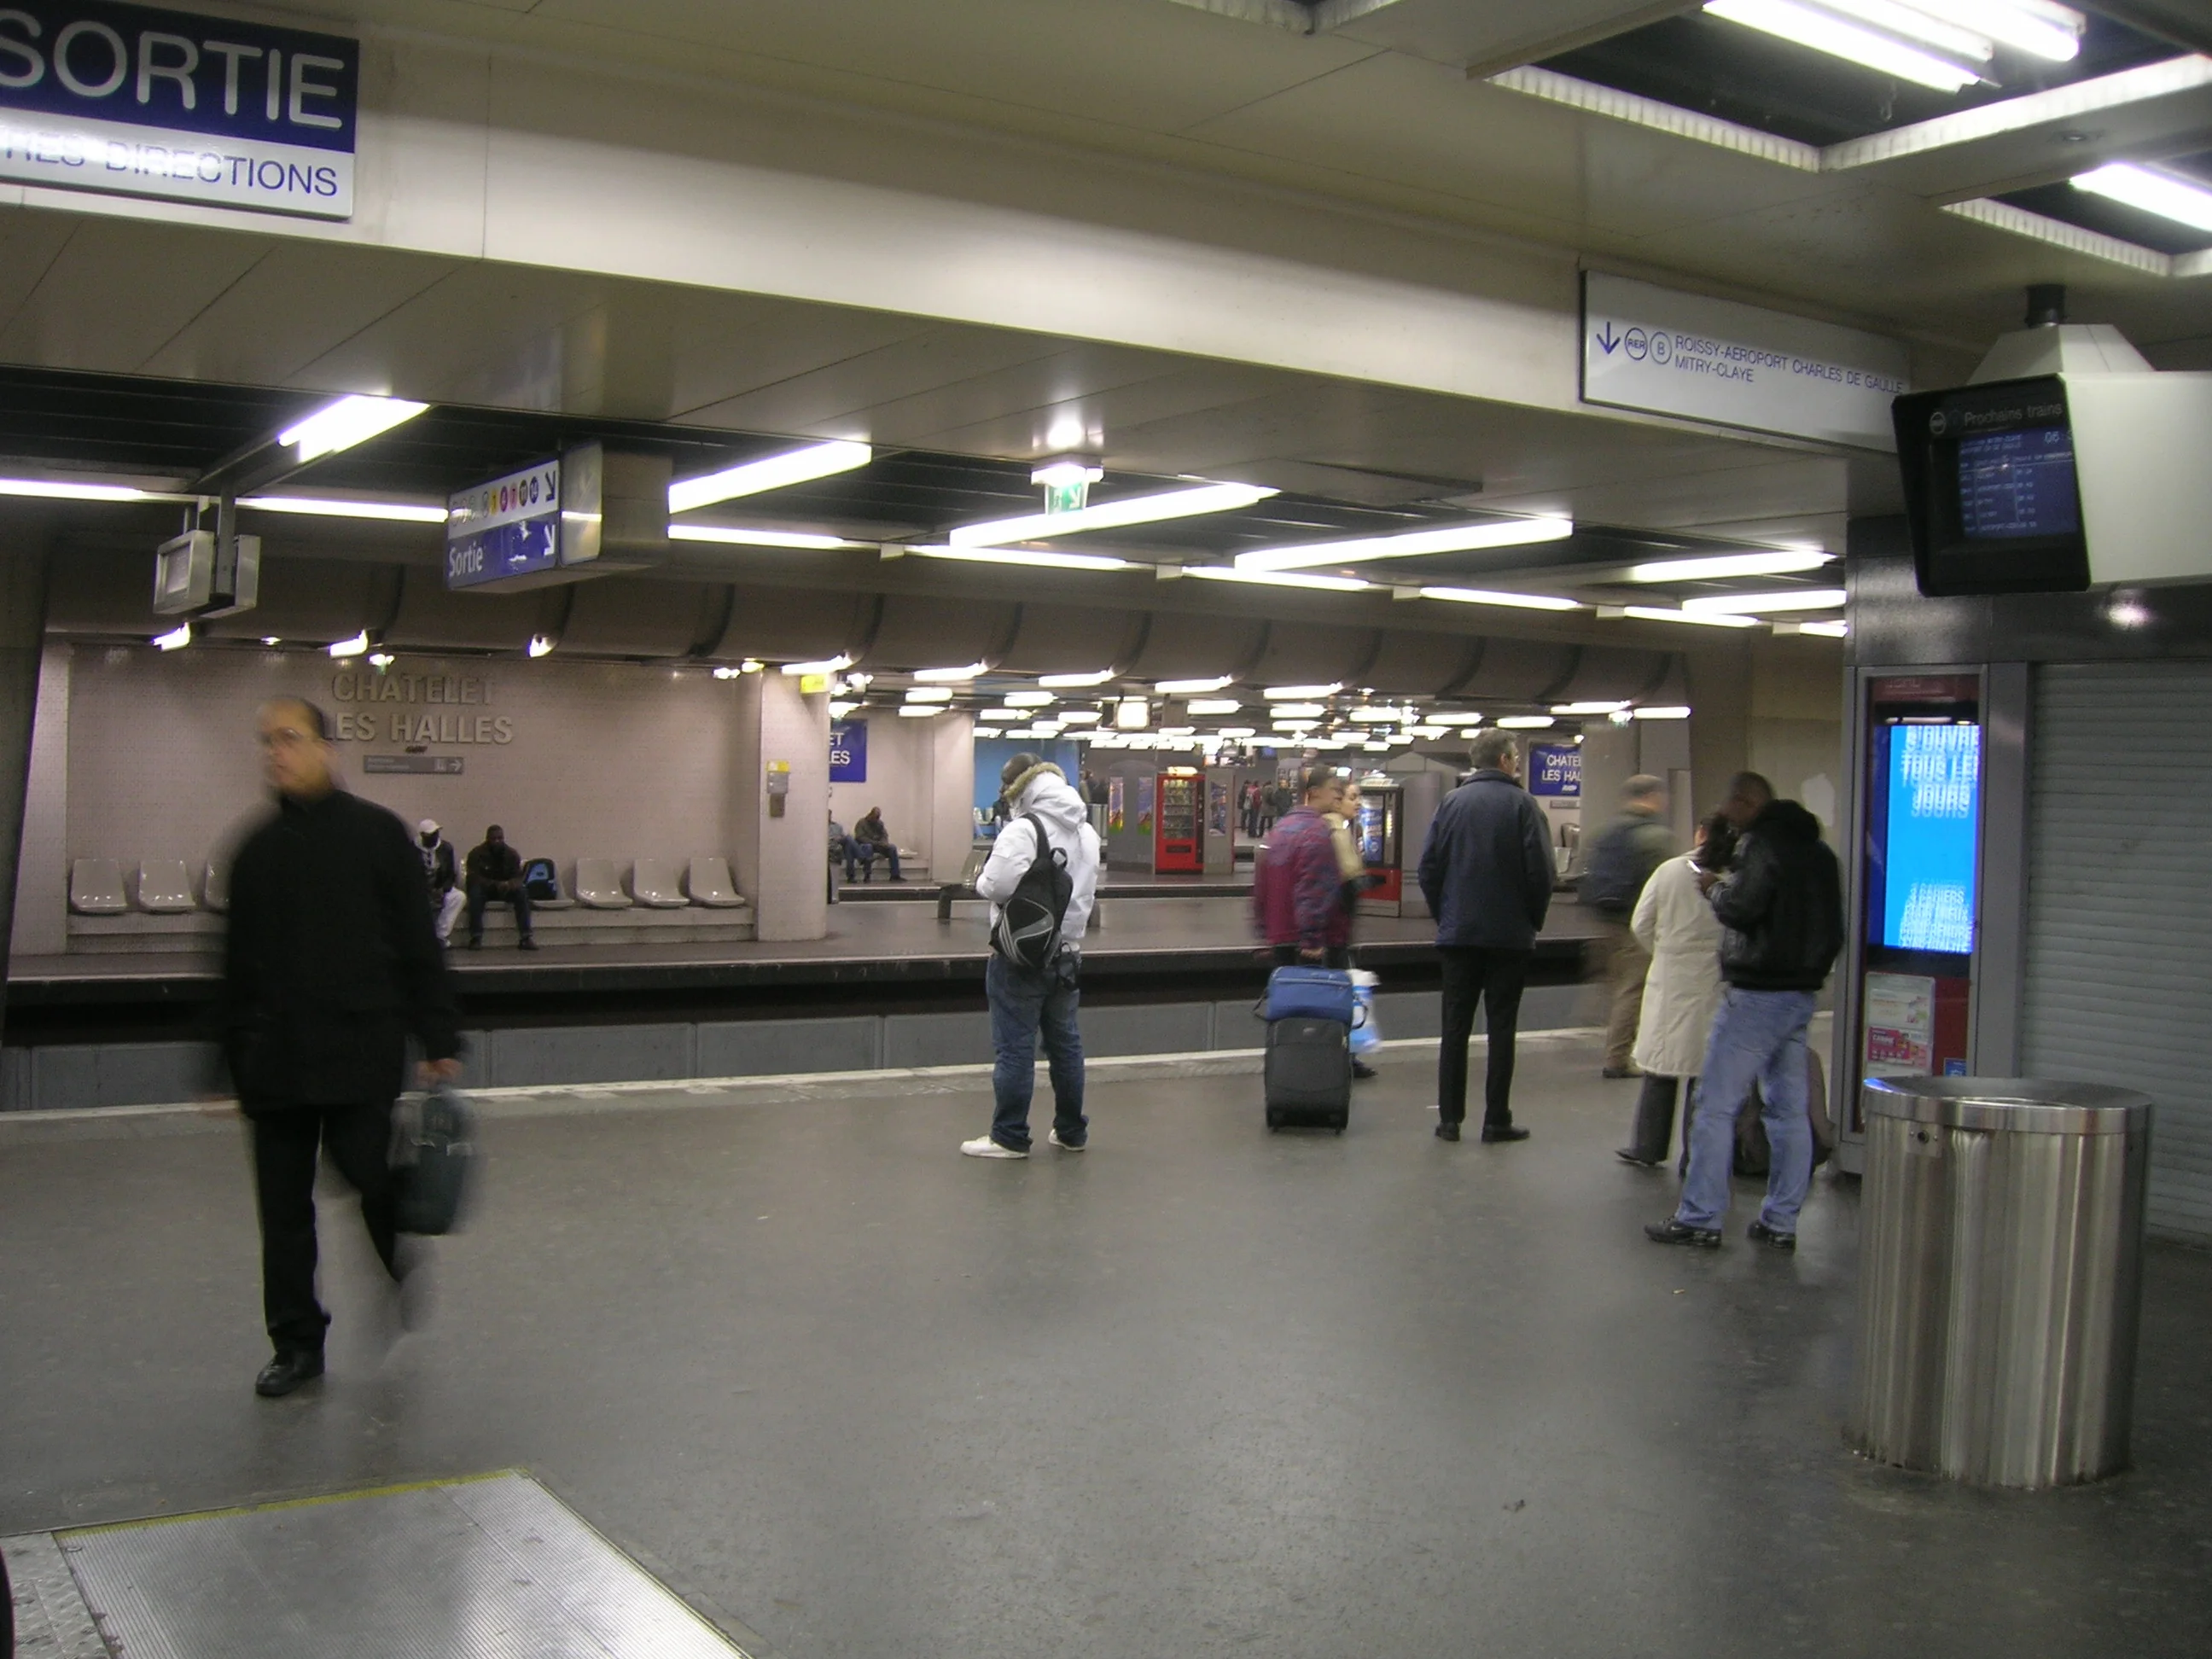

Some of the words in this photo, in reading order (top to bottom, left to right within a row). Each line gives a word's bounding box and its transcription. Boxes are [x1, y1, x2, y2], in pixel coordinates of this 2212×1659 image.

[0, 9, 343, 129] SORTIE
[106, 139, 337, 197] DIRECTIONS
[1675, 335, 1788, 370] ROISSY-AEROPORT
[1792, 358, 1842, 382] CHARLES
[1847, 370, 1860, 387] DE
[1865, 374, 1903, 394] GAULLE
[1675, 355, 1754, 382] MITRY-CLAYE
[1964, 408, 2023, 427] Prochains
[2028, 402, 2064, 419] trains
[449, 539, 484, 578] Sortie
[332, 673, 495, 705] CHATELET
[390, 713, 514, 744] HALLES
[1542, 770, 1561, 781] LES
[1546, 754, 1581, 766] CHATE
